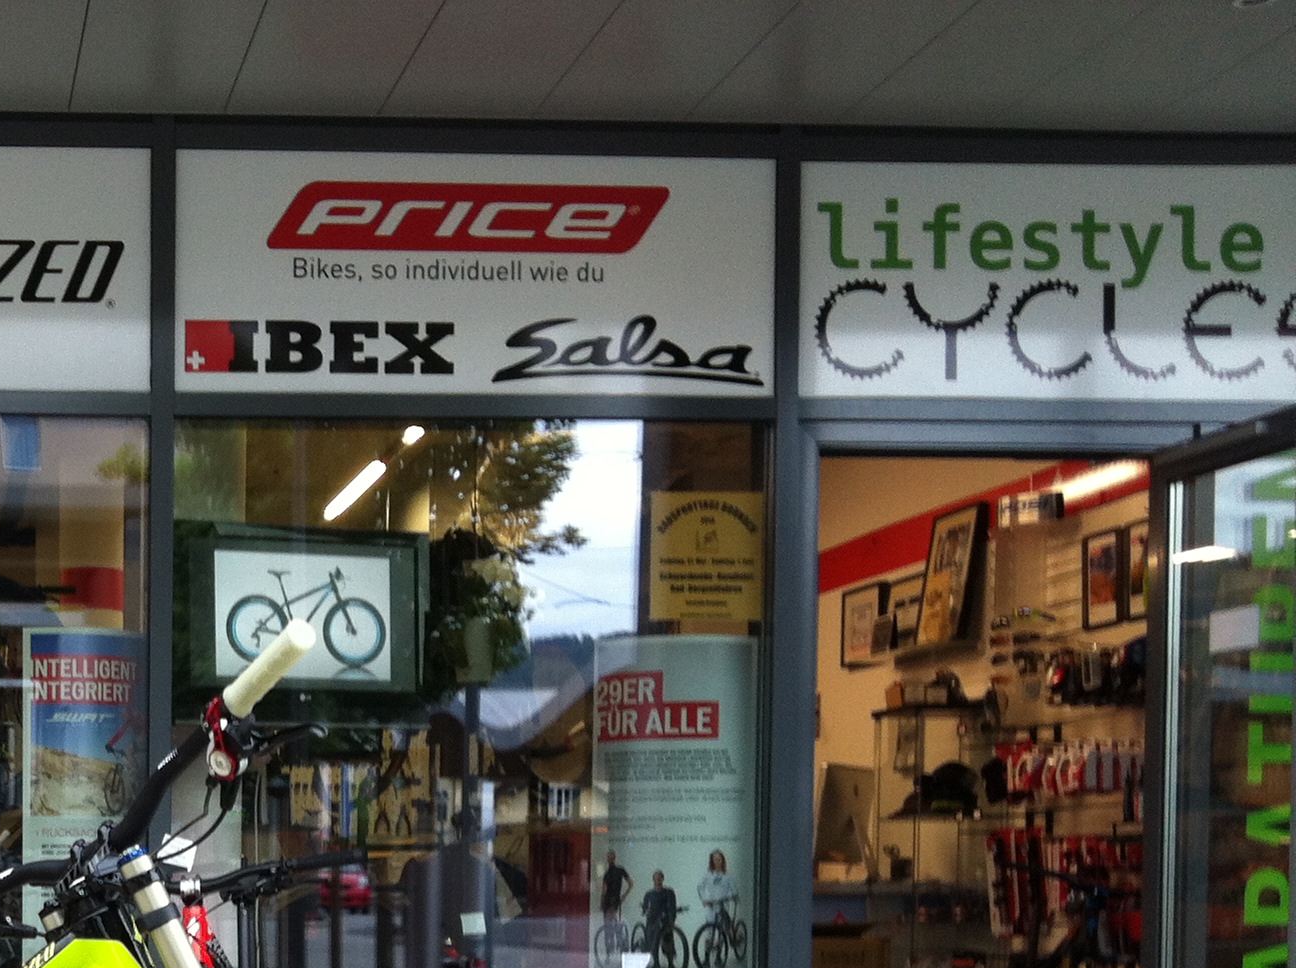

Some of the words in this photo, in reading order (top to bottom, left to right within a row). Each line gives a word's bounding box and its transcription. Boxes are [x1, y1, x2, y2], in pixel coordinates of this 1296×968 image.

[292, 257, 364, 282] Bikes,
[371, 262, 398, 281] so
[405, 259, 523, 283] individuell
[529, 260, 569, 283] wie
[576, 261, 605, 283] du
[817, 197, 1265, 289] lifestyle
[227, 319, 455, 375] IBEX
[492, 314, 765, 387] Salsa
[814, 277, 1296, 381] CYCLE
[644, 706, 713, 736] ALLE
